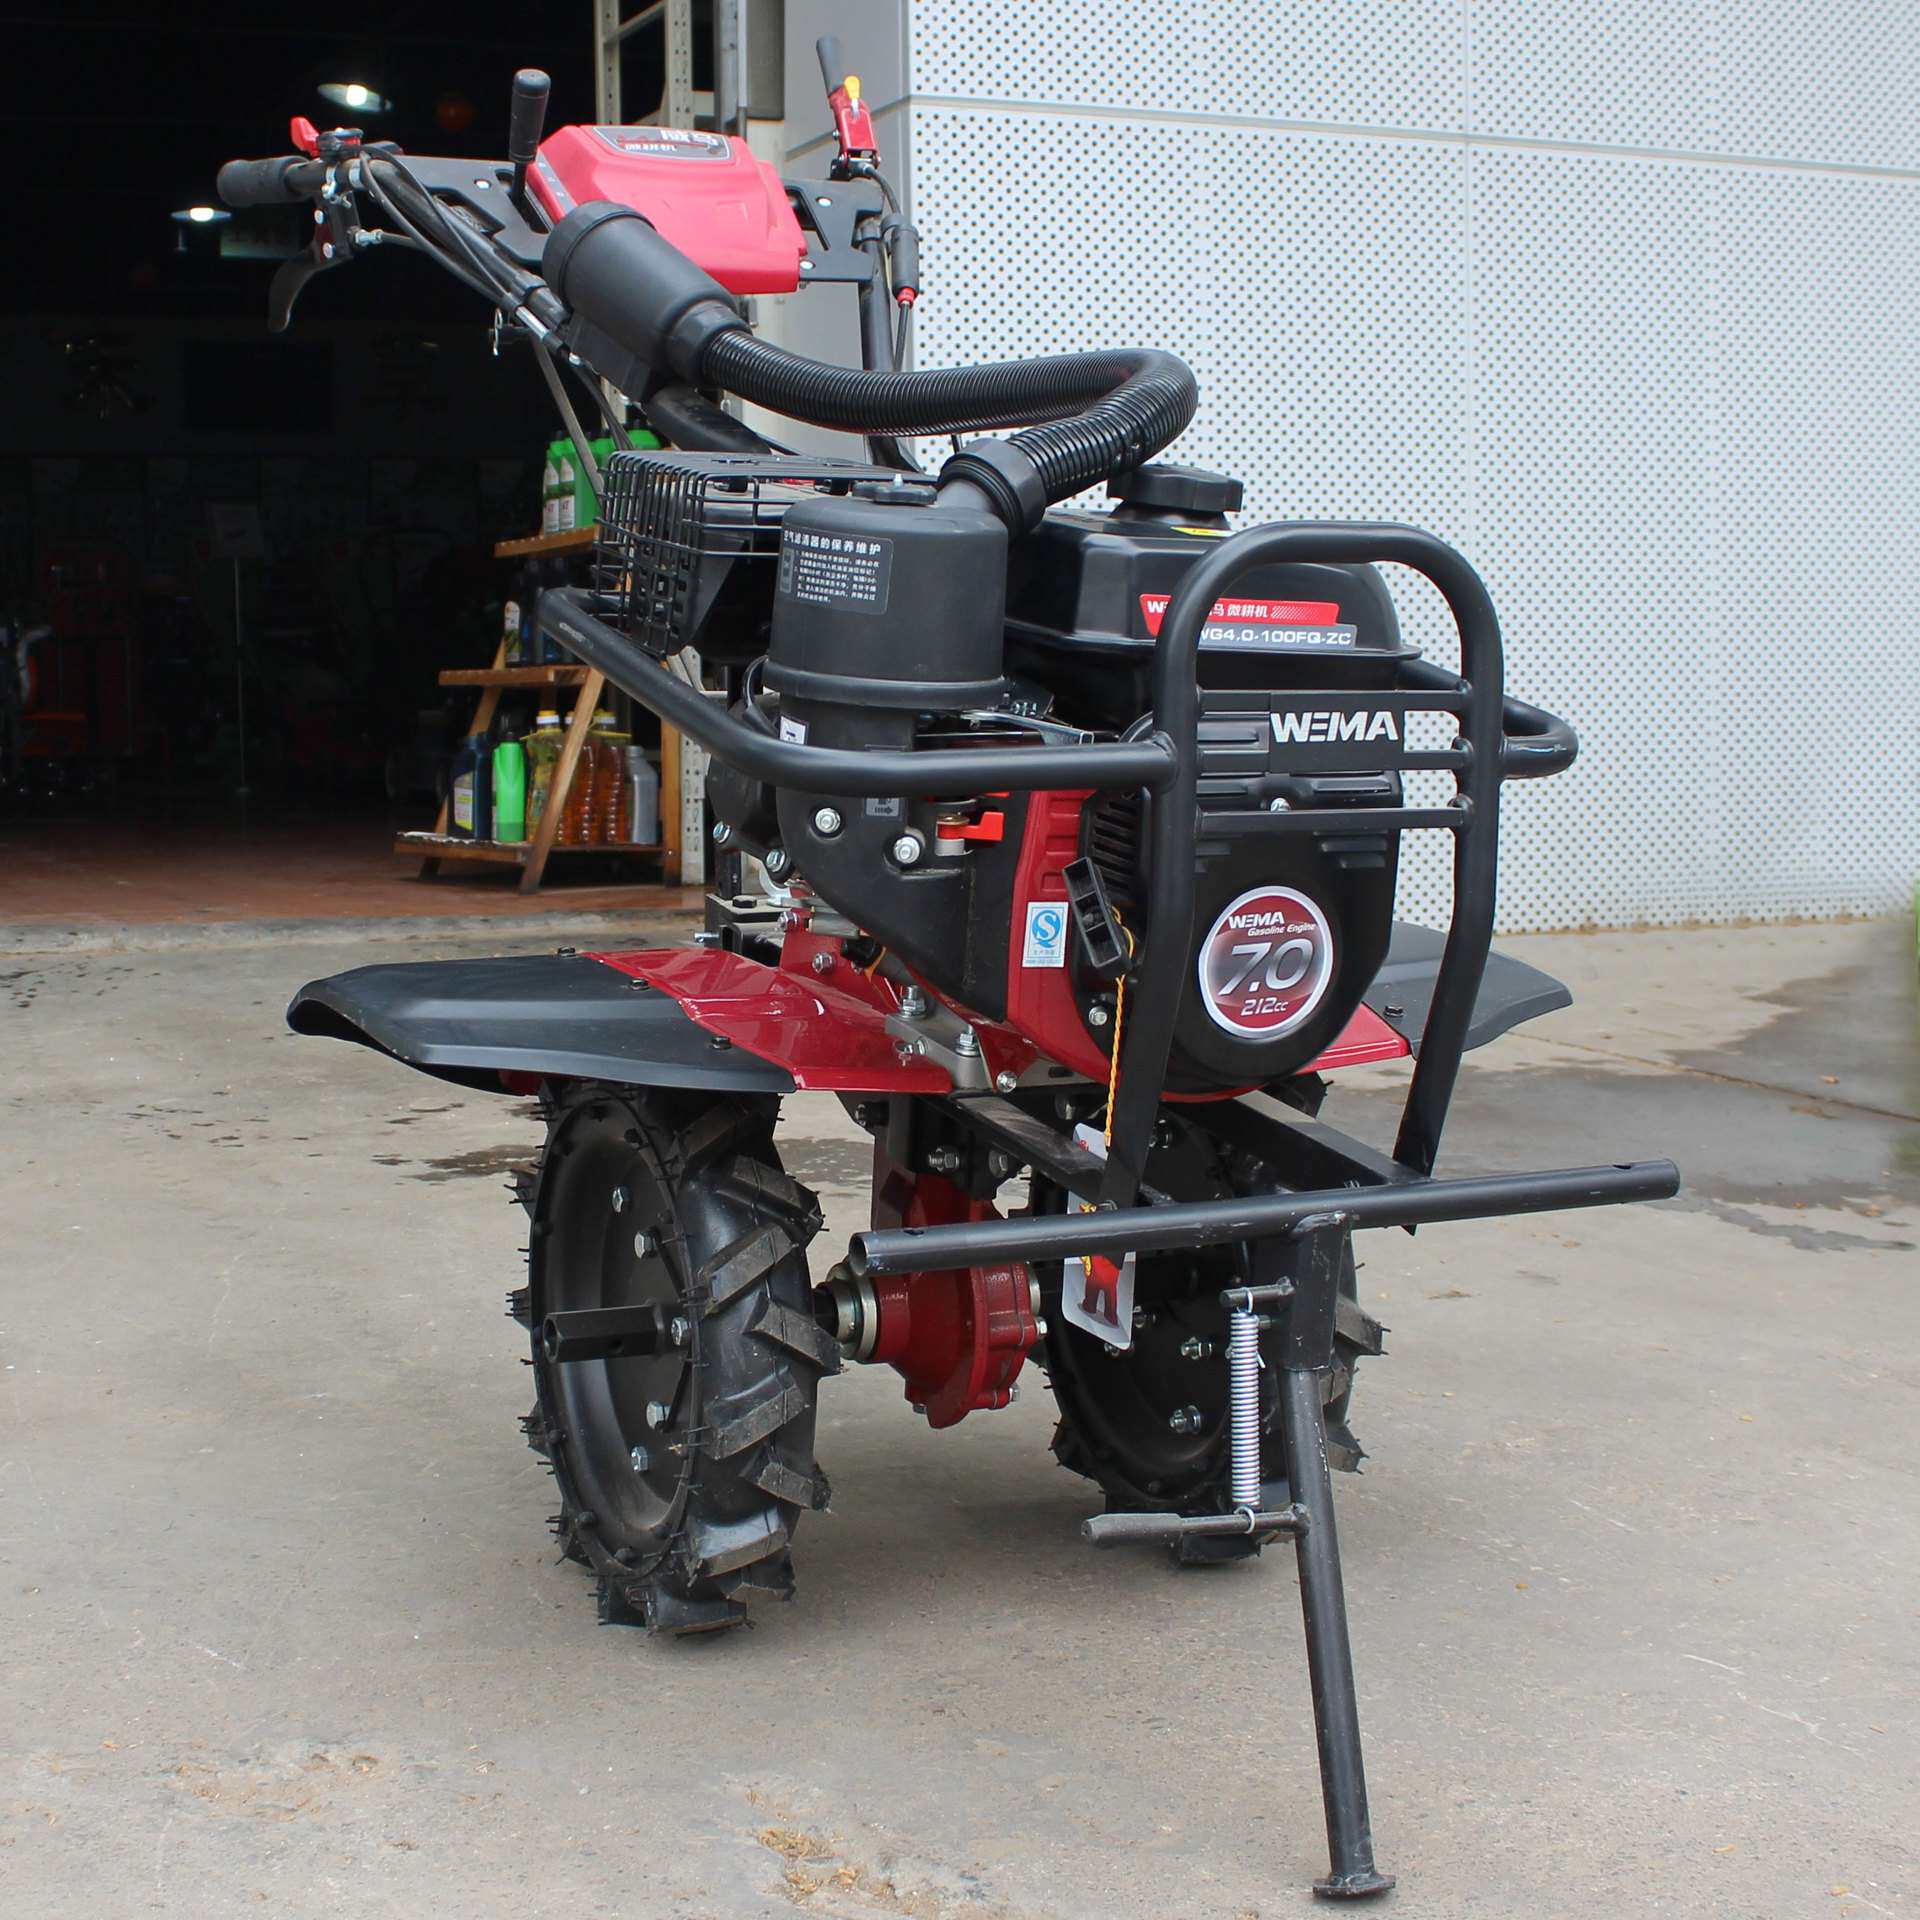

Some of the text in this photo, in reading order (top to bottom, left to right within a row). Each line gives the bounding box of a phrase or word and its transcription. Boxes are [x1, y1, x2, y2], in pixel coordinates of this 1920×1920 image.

[1227, 603, 1268, 618] 微耕机
[1270, 711, 1399, 743] WEMA
[1228, 911, 1285, 929] WEMA
[1247, 922, 1317, 938] Gasoline Engine
[1217, 938, 1314, 996] 7.0
[1240, 996, 1289, 1017] 212cc
